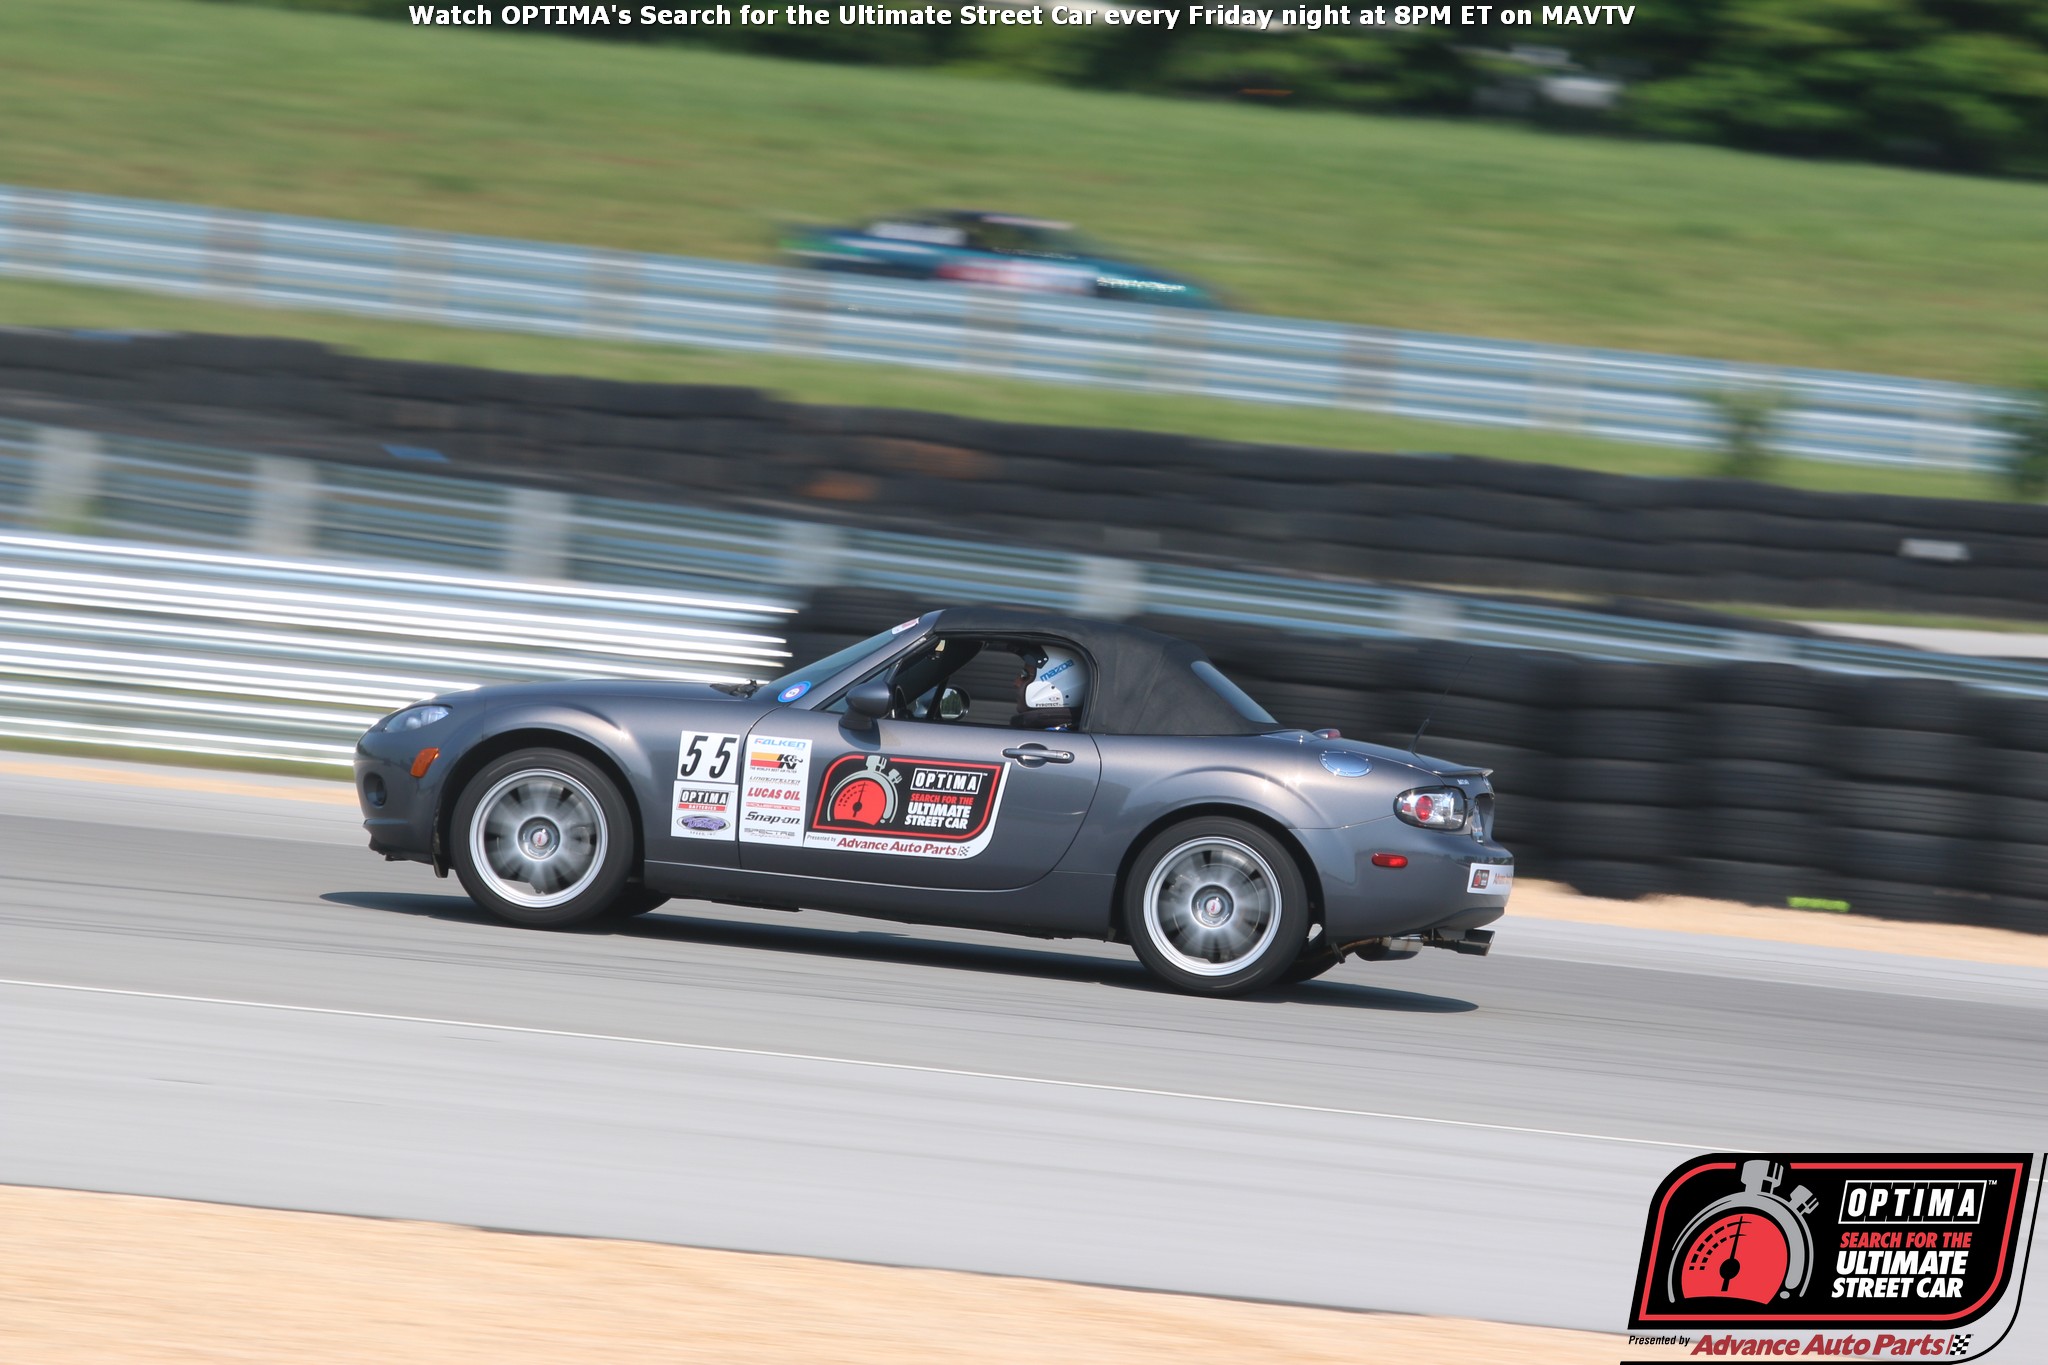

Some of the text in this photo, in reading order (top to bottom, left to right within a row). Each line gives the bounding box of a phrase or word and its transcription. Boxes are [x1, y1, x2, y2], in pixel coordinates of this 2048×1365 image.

[1040, 659, 1074, 682] mazda
[754, 738, 806, 749] FALKEN
[914, 772, 977, 791] OPTIMA
[681, 790, 727, 804] OPTIMA
[747, 787, 801, 801] LUCAS OIL
[910, 793, 975, 806] SEARCH FOR THE
[908, 802, 971, 818] ULTIMATE
[745, 811, 801, 825] Snap-on
[904, 814, 968, 830] STREET CAR
[836, 837, 957, 856] Advance Auto Parts
